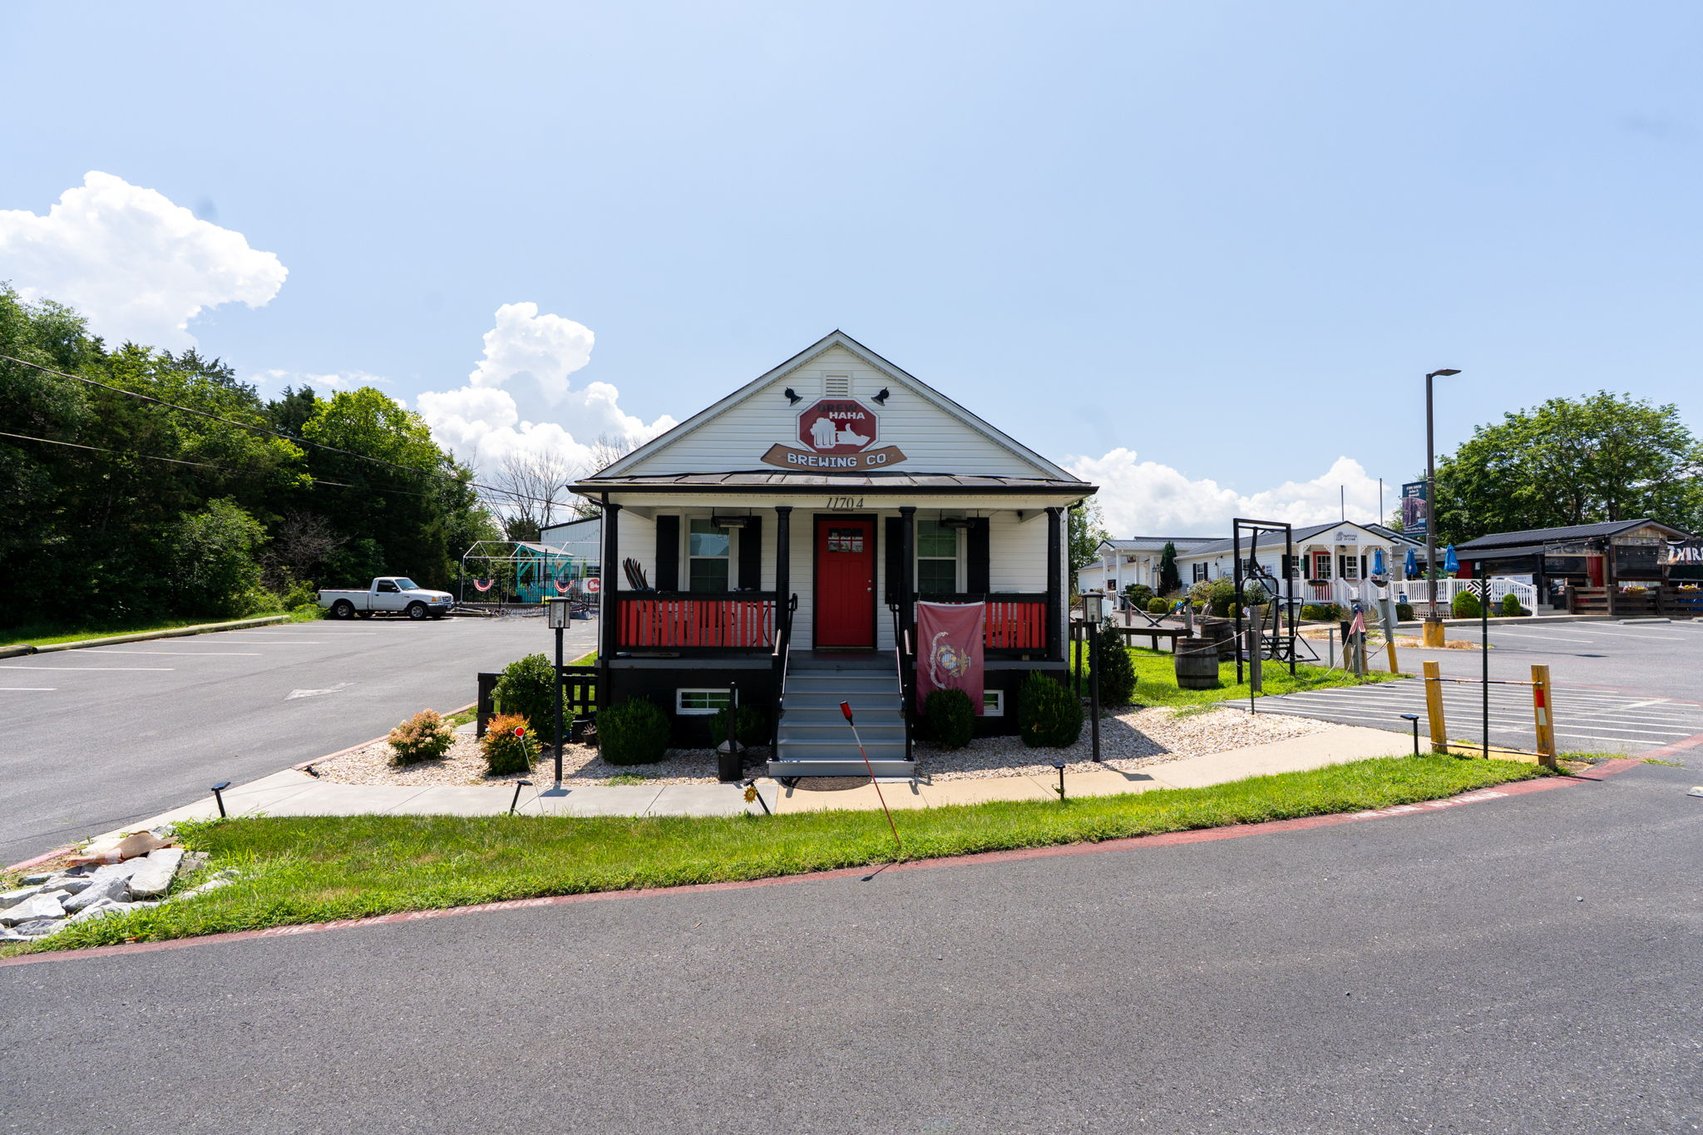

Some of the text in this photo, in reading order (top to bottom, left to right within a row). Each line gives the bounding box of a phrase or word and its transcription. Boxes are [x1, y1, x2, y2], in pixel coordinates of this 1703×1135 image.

[829, 411, 866, 420] HAHA
[787, 452, 887, 468] BREWING CO
[826, 497, 864, 509] 11704
